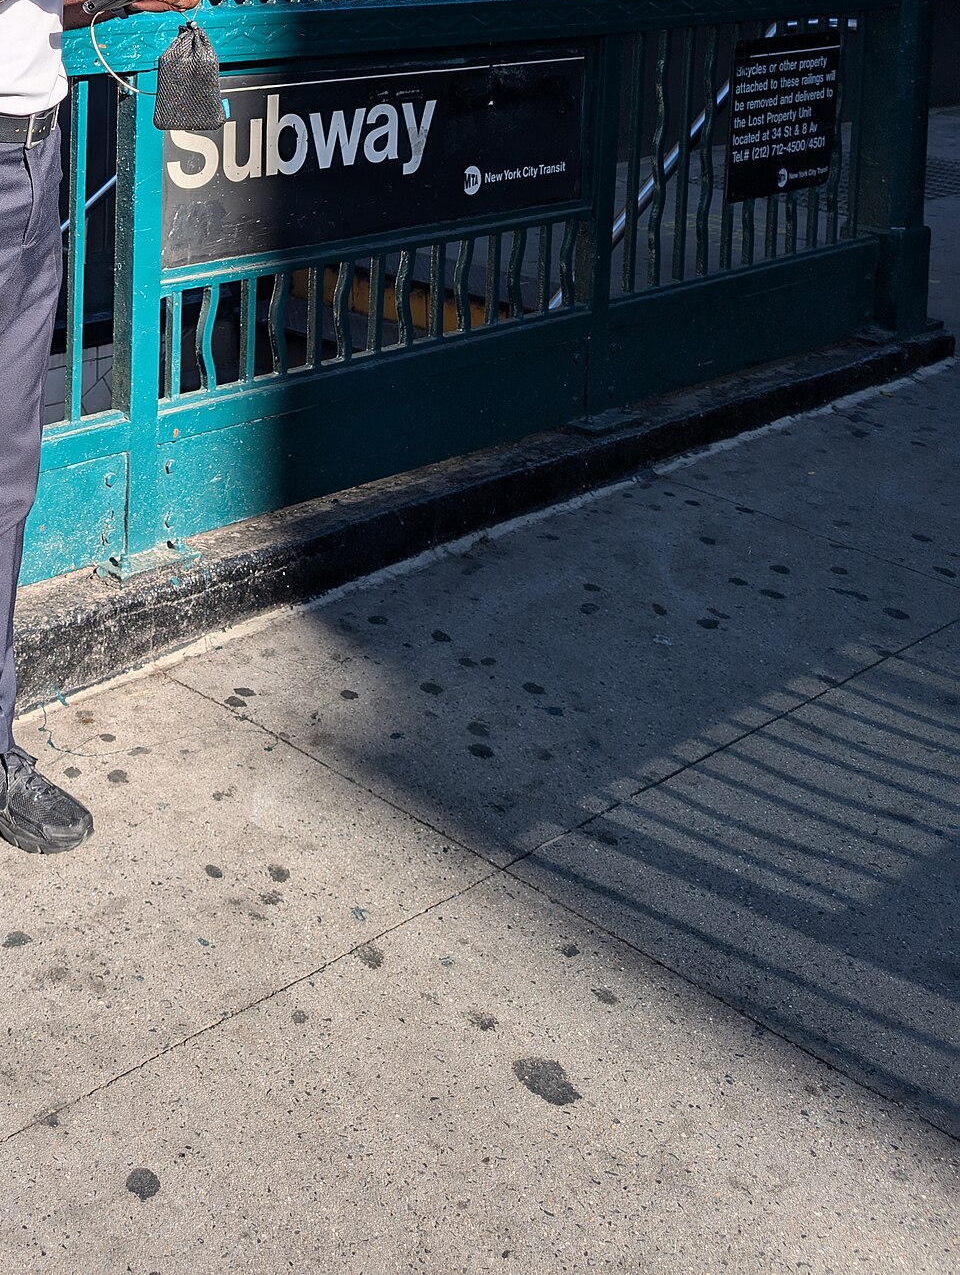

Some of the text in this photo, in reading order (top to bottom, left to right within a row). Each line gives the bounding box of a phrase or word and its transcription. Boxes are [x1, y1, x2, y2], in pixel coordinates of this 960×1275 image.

[769, 64, 777, 73] or
[779, 59, 797, 72] other
[799, 56, 828, 70] property
[735, 70, 836, 94] attached to these railings will
[734, 87, 833, 111] be removed and delivered to
[734, 106, 812, 129] the Lost Property Unit
[166, 94, 437, 189] Subway
[732, 122, 818, 146] located at 34 St & 8 Av
[751, 145, 770, 161] (212)
[484, 161, 566, 184] New York City Transit
[808, 168, 817, 176] City
